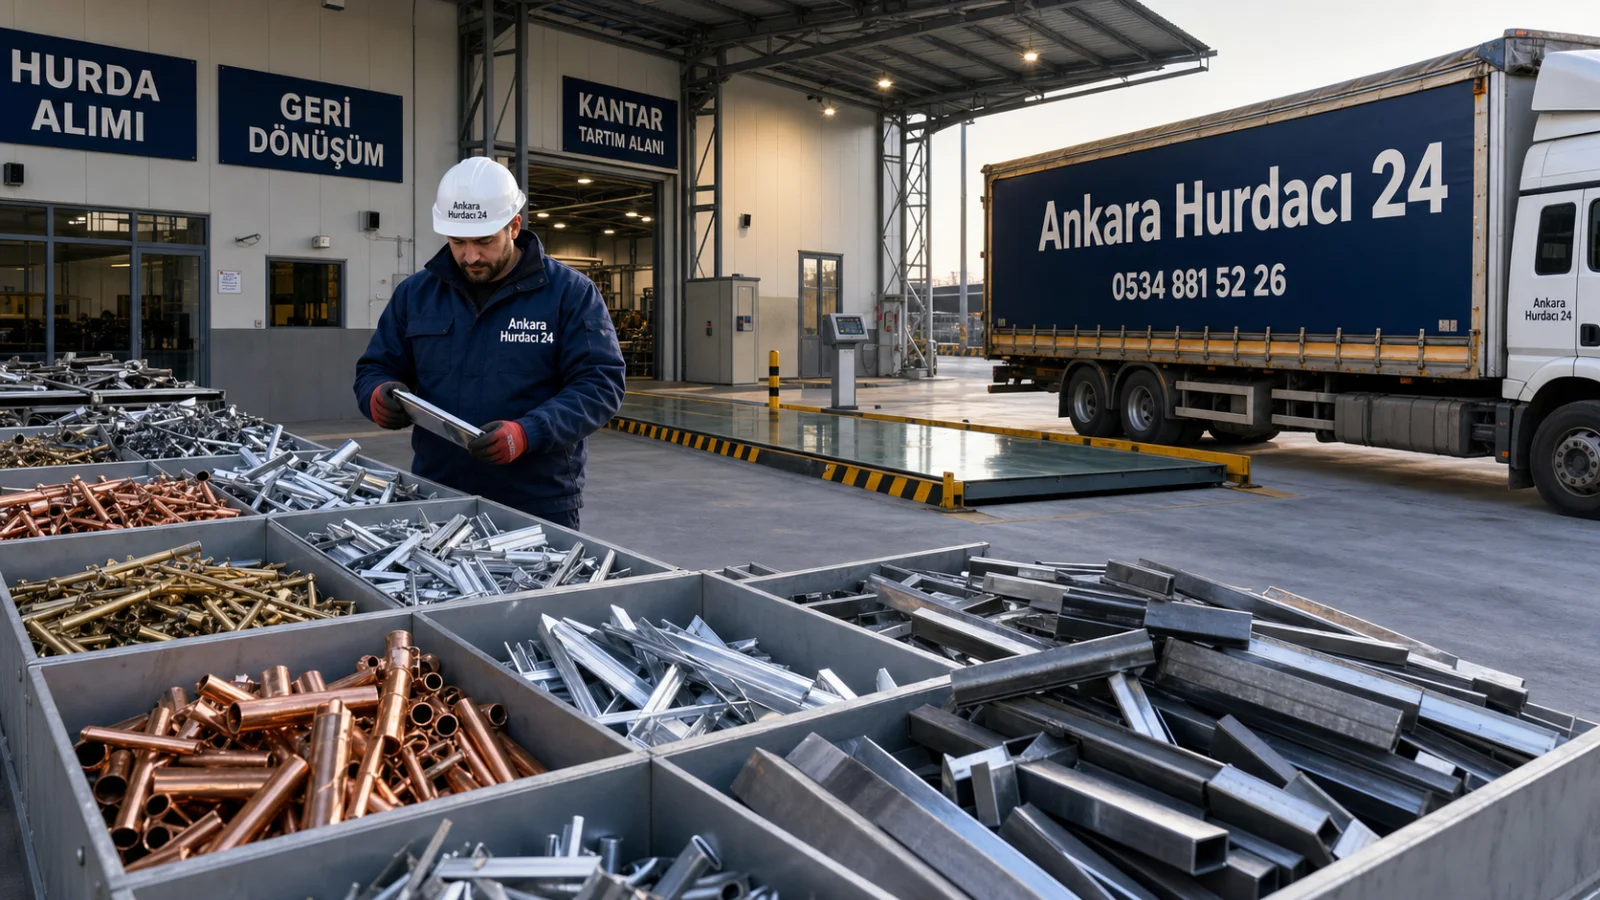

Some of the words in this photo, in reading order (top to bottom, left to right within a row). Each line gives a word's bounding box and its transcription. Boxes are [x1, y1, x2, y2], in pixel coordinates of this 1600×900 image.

[12, 48, 160, 102] HURDA
[31, 99, 144, 142] ALIMI
[280, 92, 351, 128] GERİ
[578, 91, 663, 132] KANTAR
[248, 123, 384, 170] DÖNÜŞÜM
[578, 125, 625, 149] TARTIM
[628, 135, 665, 155] ALANI
[453, 201, 480, 210] Ankara
[1038, 193, 1161, 252] Ankara
[1175, 165, 1352, 239] Hurdacı
[1371, 141, 1449, 219] 24
[448, 210, 476, 219] Hurdacı
[477, 210, 488, 219] 24
[1112, 270, 1166, 301] 0534
[1171, 267, 1207, 299] 881
[1215, 264, 1246, 298] 52
[1253, 262, 1287, 297] 26
[1525, 310, 1559, 321] Hurdacı
[1560, 310, 1572, 321] 24
[1533, 297, 1566, 308] Ankara
[500, 330, 539, 343] Hurdacı
[540, 332, 554, 343] 24
[508, 317, 547, 330] Ankara
